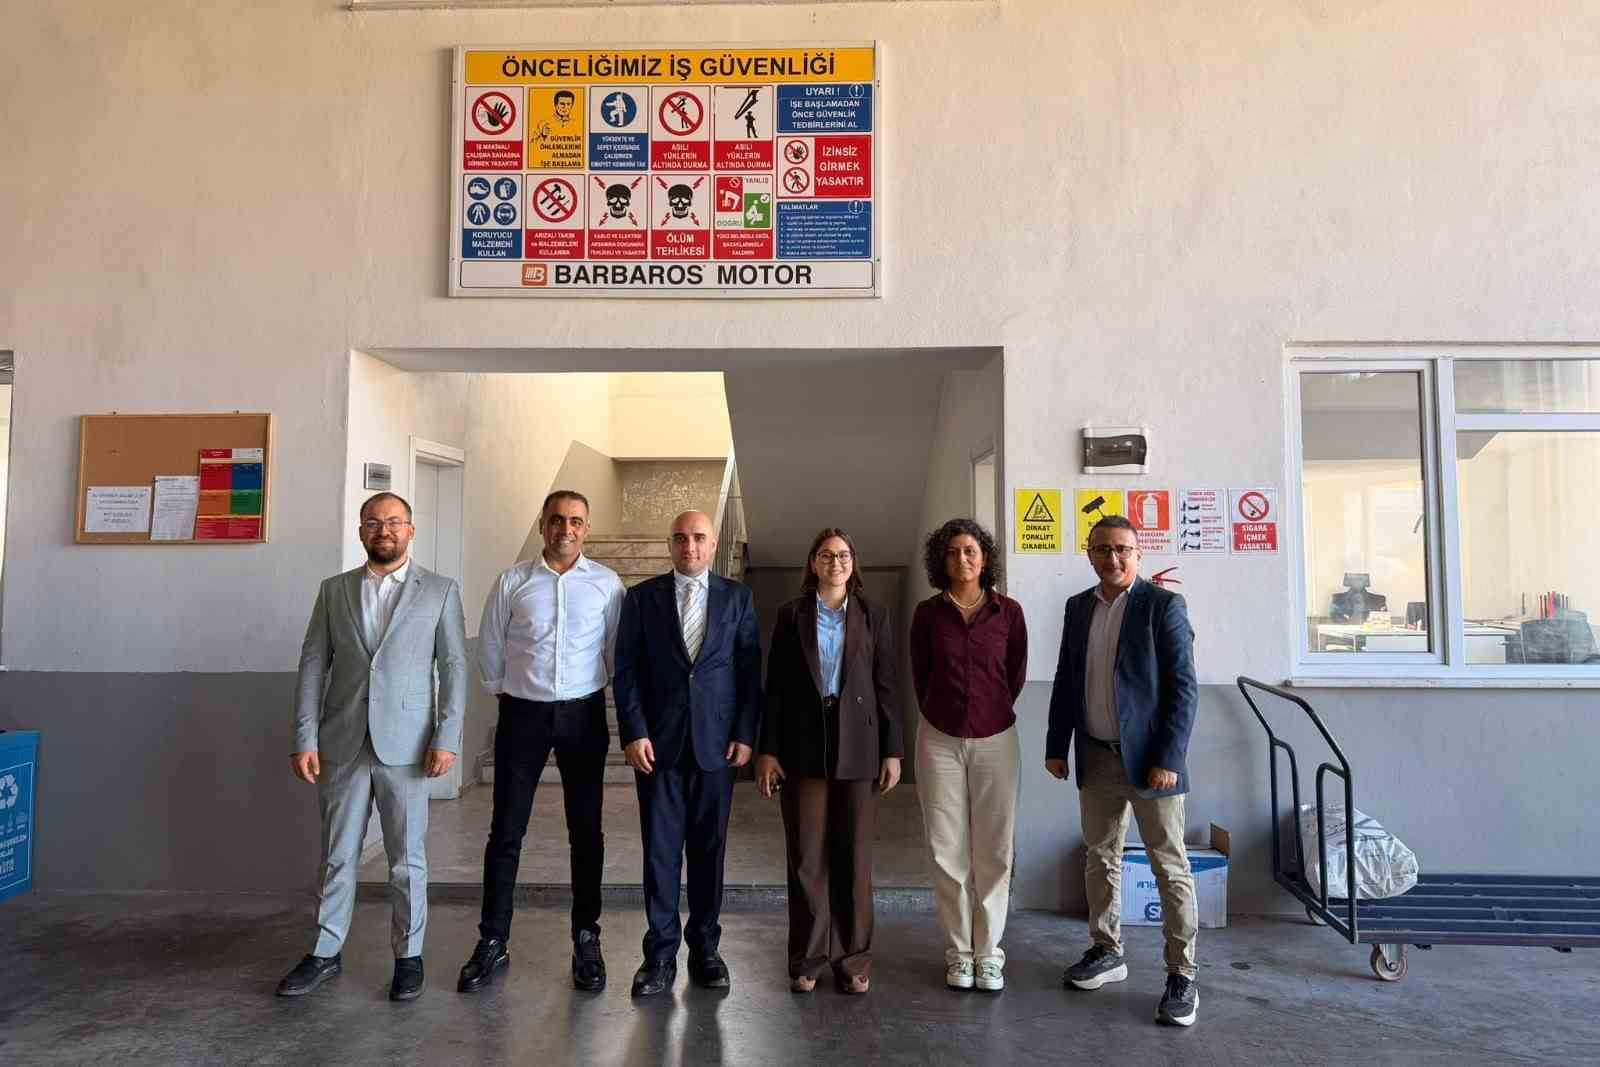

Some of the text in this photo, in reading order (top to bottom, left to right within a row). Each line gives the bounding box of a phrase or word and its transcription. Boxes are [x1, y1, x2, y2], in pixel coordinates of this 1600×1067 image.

[502, 52, 835, 80] ÖNCELİĞİMİZ İŞ GÜVENLİĞİ
[805, 87, 835, 96] UYARI
[792, 110, 856, 118] ÖNCE GÜVENLİK
[822, 145, 858, 157] İZİNSİZ
[819, 160, 860, 171] GİRMEK
[816, 176, 864, 186] YASAKTIR
[472, 231, 513, 239] KORUYUCU
[666, 231, 695, 243] ÖLÜM
[655, 245, 705, 256] TEHLİKESİ
[554, 264, 704, 285] BARBAROS
[717, 264, 812, 285] MOTOR
